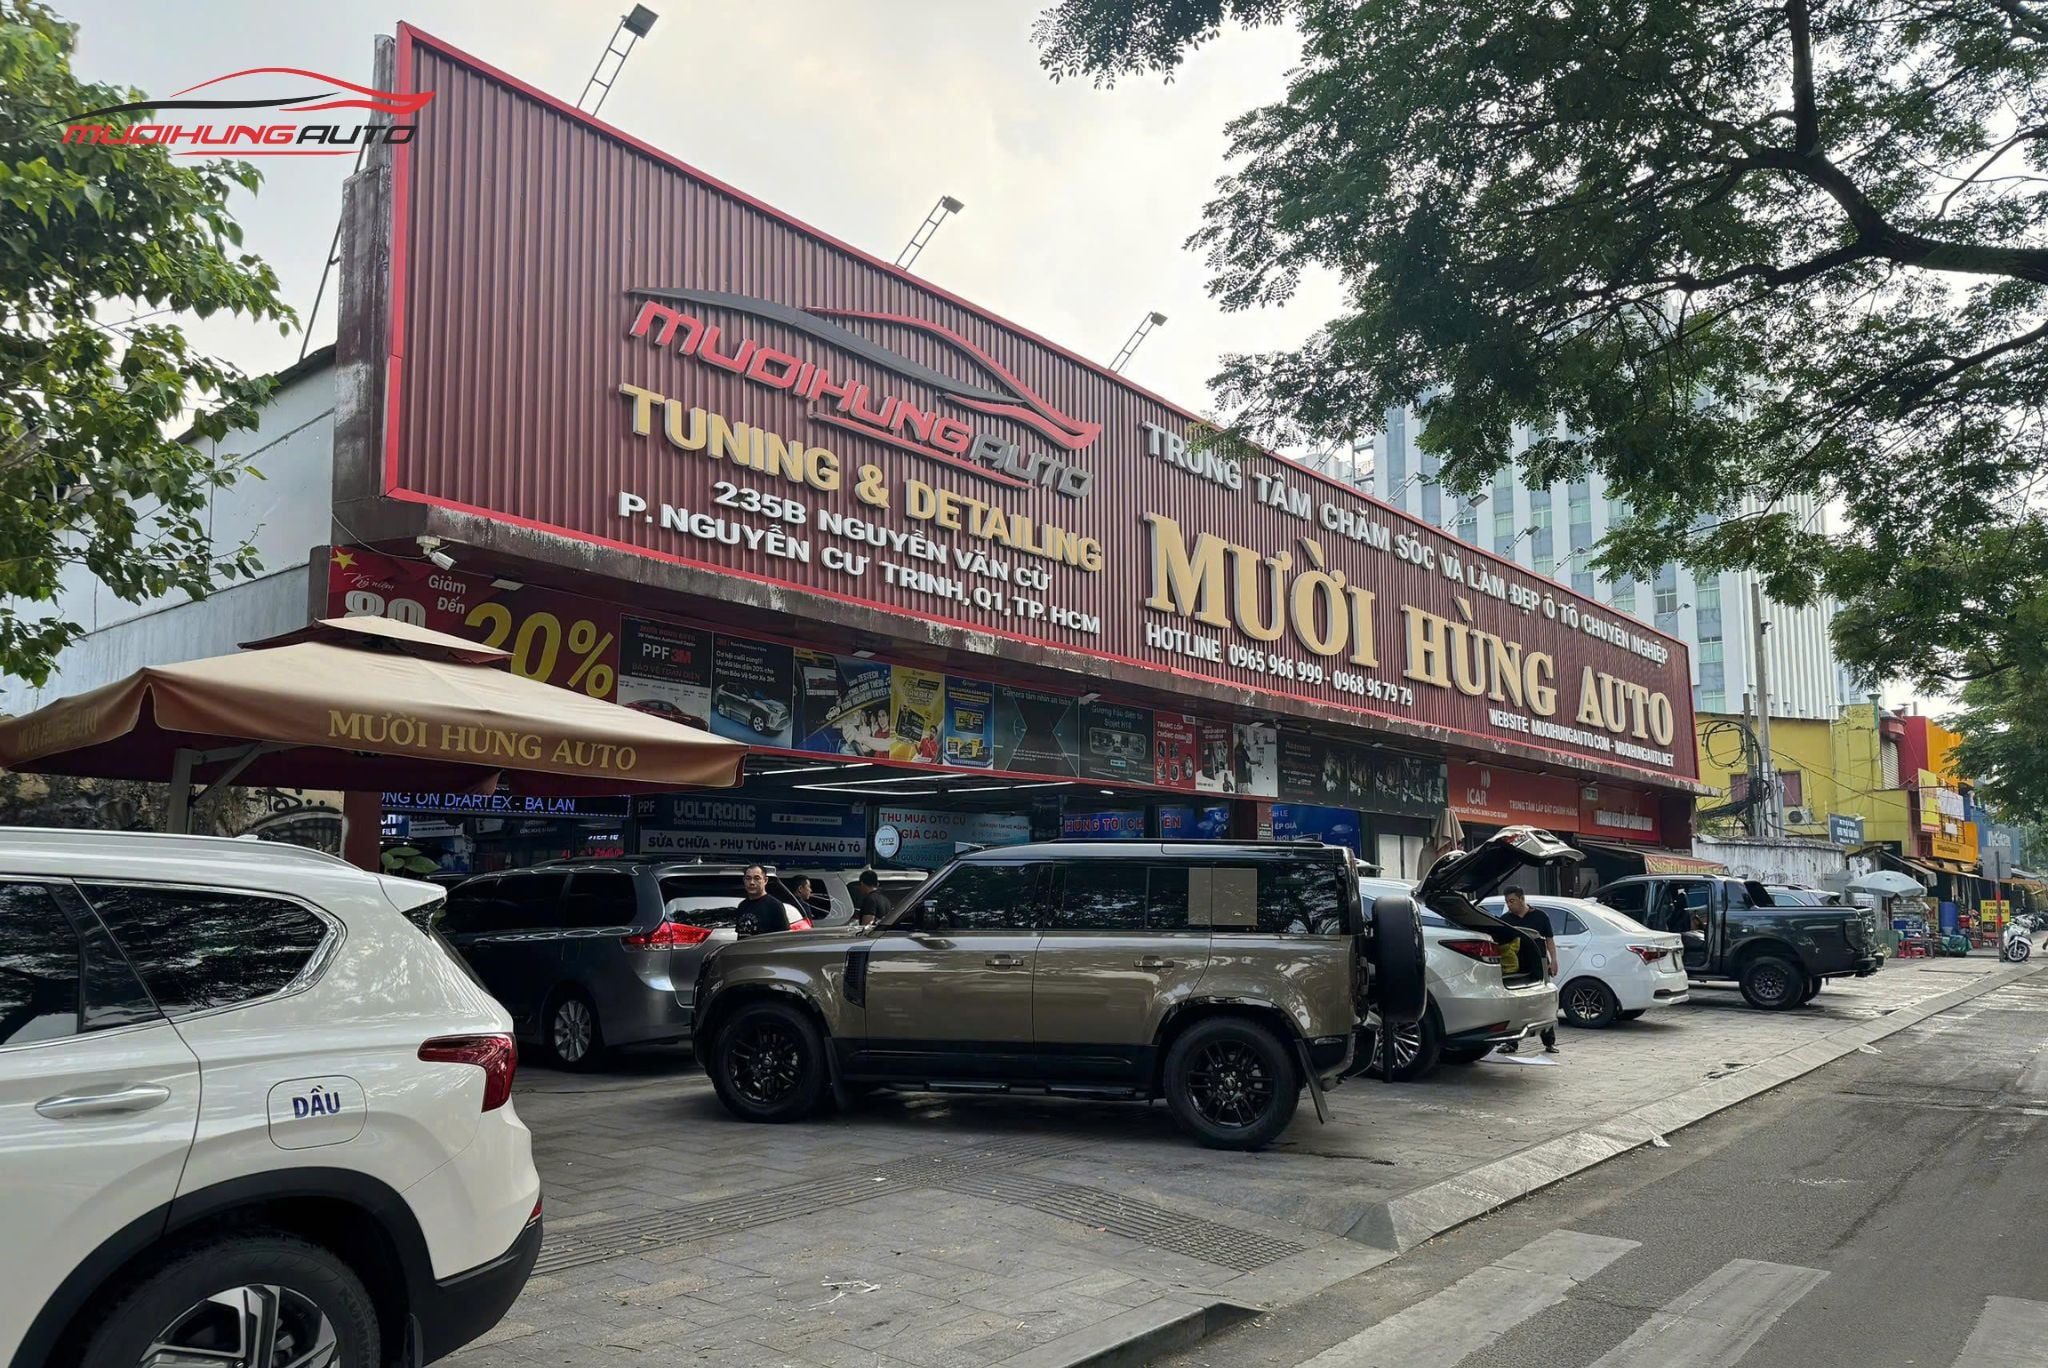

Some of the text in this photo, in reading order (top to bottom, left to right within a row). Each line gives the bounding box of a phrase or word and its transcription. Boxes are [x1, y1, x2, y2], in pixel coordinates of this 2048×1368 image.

[618, 382, 1101, 573] TUNING & DETAILING
[618, 491, 653, 523] P.
[660, 503, 810, 563] NGUYỄN
[821, 546, 870, 576] CƯ
[713, 481, 1052, 591] 235B NGUYỄN VĂN CỪ
[1142, 421, 1242, 490] TRUNG
[1252, 472, 1312, 521] TÂM
[1319, 502, 1390, 552] CHĂM
[1438, 549, 1464, 584] VÀ
[1466, 563, 1505, 600] LÀM
[1508, 583, 1539, 615] ĐẸP
[1543, 592, 1556, 619] Ô
[1558, 602, 1579, 629] TÔ
[1581, 613, 1630, 651] CHUYÊN
[1630, 634, 1669, 669] NGHIỆP
[428, 574, 467, 594] Giảm
[437, 596, 466, 615] Đến
[1143, 511, 1674, 746] MƯỜI HÙNG AUTO
[464, 601, 614, 698] 20%
[642, 643, 670, 660] PPF
[1228, 644, 1265, 673] 0965
[1267, 654, 1294, 680] 966
[1296, 662, 1323, 685] 999
[1333, 670, 1365, 696] 0968
[1399, 686, 1413, 706] 79
[328, 709, 637, 770] MƯỜI HÙNG AUTO
[444, 793, 512, 809] DrARTEX
[525, 796, 544, 810] BA
[548, 797, 575, 811] LAN
[637, 799, 756, 820] PPF VOLTRONIC
[1466, 787, 1487, 806] ICAR
[880, 812, 902, 821] THU
[905, 813, 927, 823] MUA
[648, 832, 673, 848] SỬA
[677, 835, 710, 849] CHỮA
[720, 841, 743, 853] PHỤ
[746, 836, 776, 850] TÙNG
[785, 838, 806, 851] MÁY
[809, 842, 836, 854] LẠNH
[838, 839, 845, 852] Ô
[848, 840, 861, 853] TÔ
[901, 826, 947, 840] GIÁ CAO
[292, 1085, 340, 1118] DẦU
